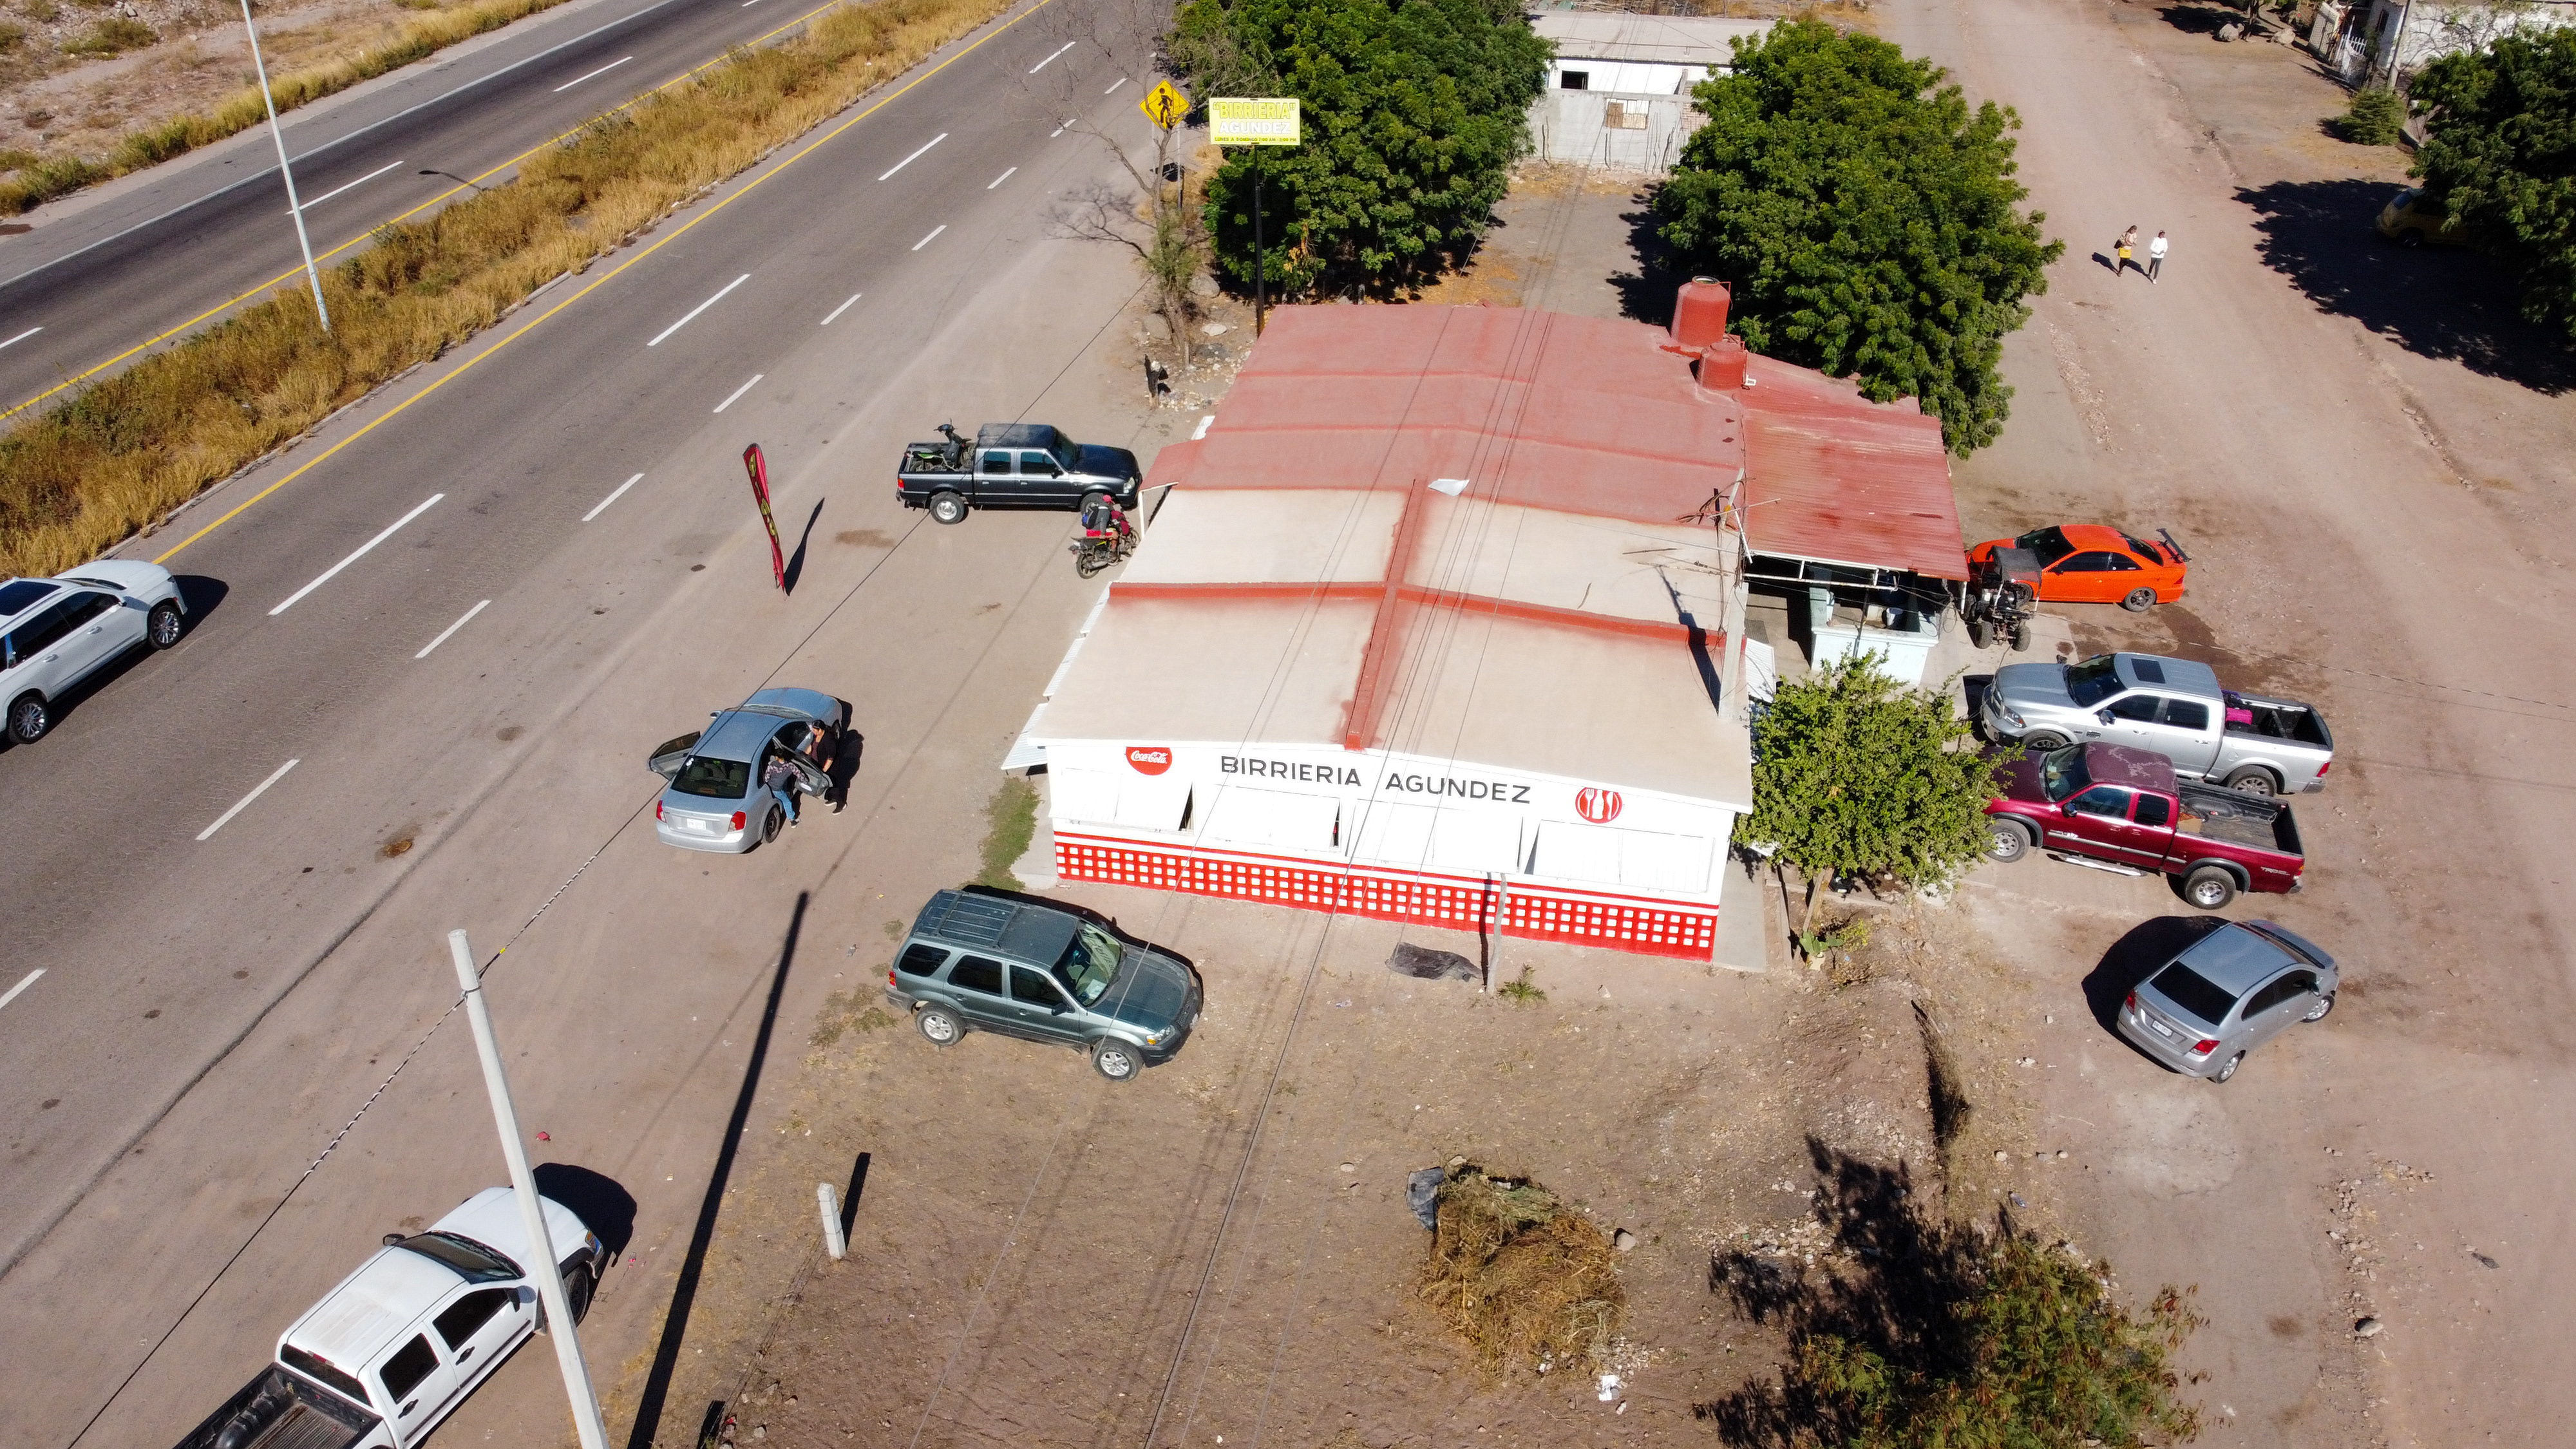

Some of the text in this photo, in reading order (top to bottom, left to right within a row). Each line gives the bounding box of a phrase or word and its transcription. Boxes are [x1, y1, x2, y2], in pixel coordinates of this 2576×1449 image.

[1219, 121, 1292, 134] AGUNDEZ
[1130, 750, 1168, 764] Coca-Cola
[1220, 755, 1531, 804] BIRRIERIA AGUNDEZ
